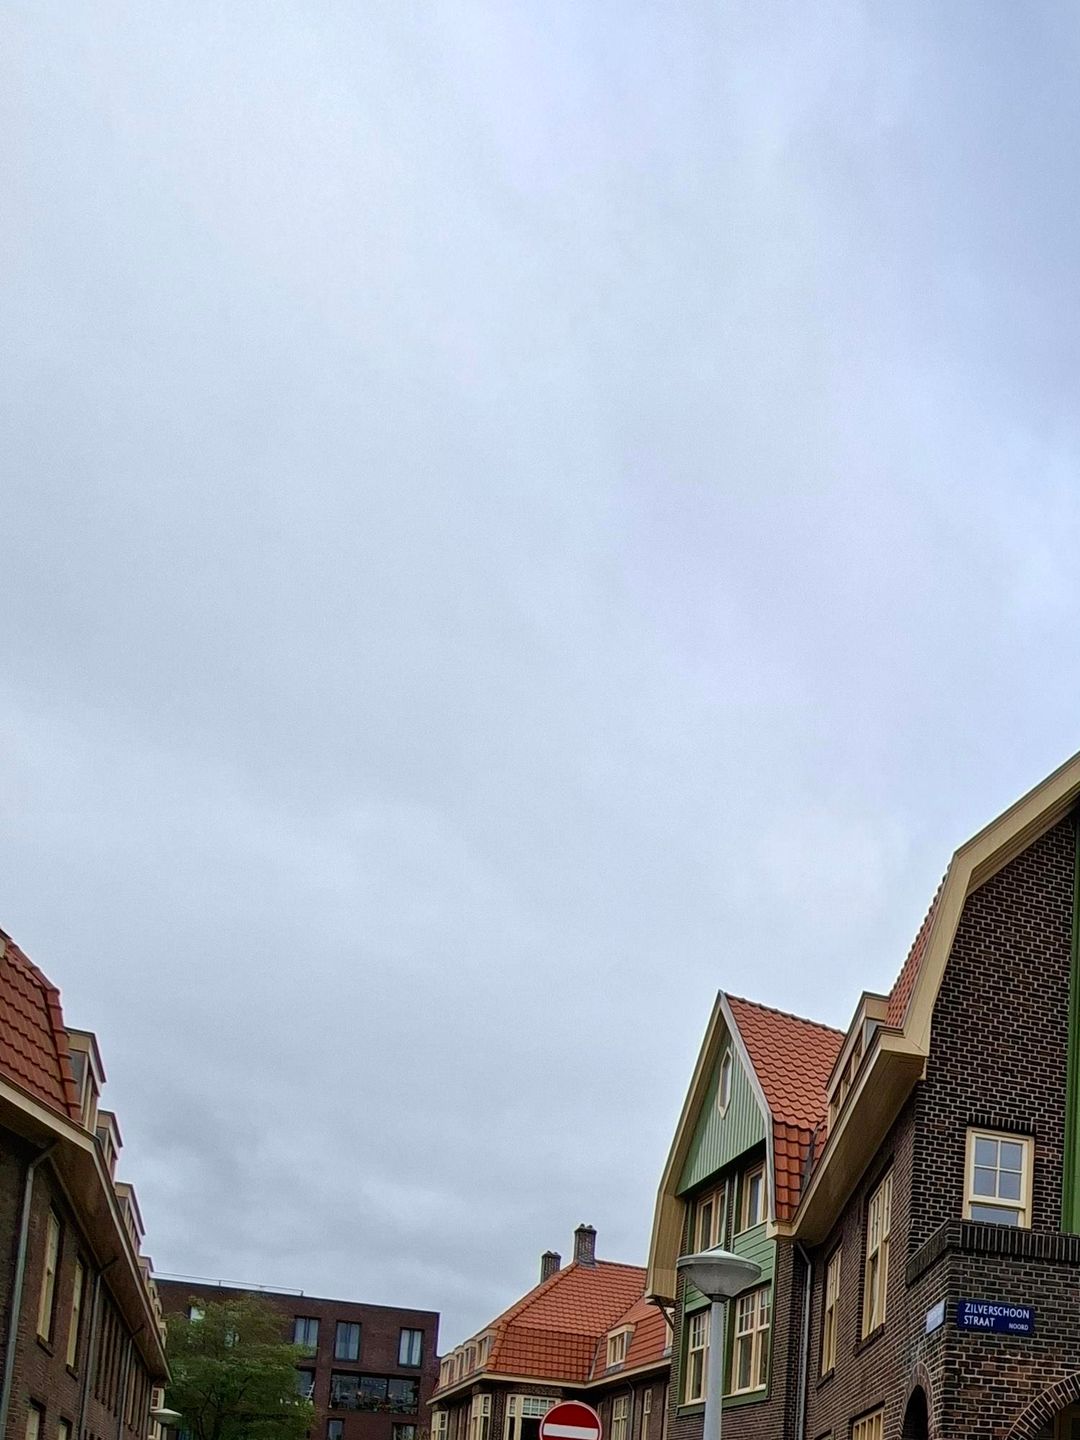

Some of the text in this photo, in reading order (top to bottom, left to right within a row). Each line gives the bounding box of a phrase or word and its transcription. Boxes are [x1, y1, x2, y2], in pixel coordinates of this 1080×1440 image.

[964, 1303, 1030, 1319] ZILVERSCHOON
[963, 1314, 995, 1327] STRAAT
[1008, 1322, 1029, 1331] NOORD
